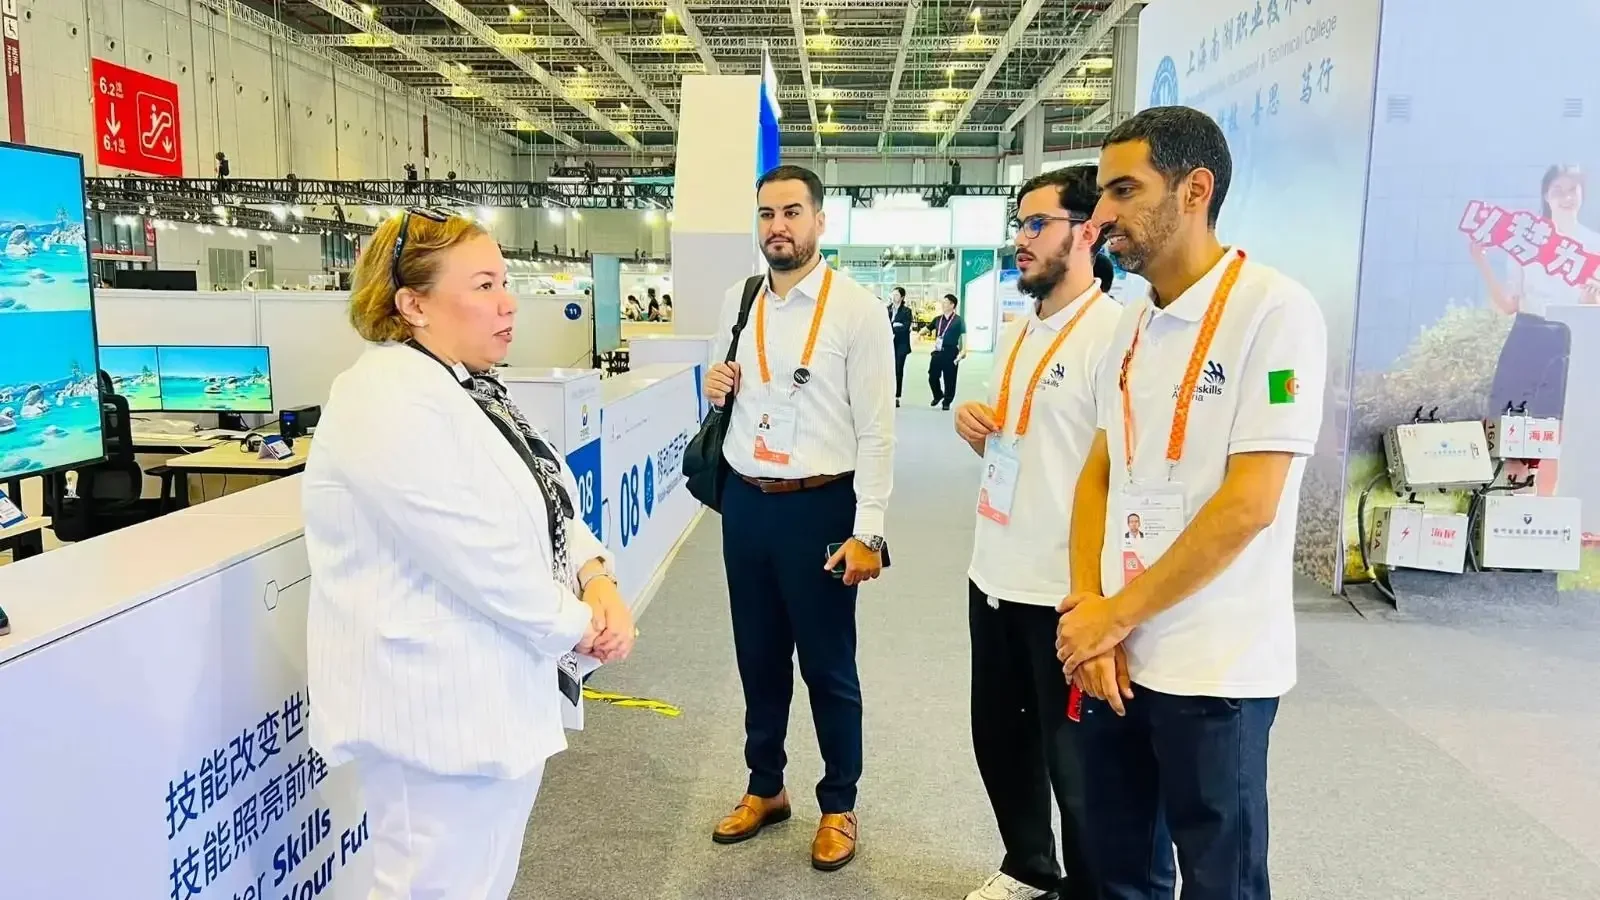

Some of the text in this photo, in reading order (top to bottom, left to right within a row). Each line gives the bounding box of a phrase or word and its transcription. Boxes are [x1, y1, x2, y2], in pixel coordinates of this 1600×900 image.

[1459, 201, 1600, 285] 以梦为
[1171, 391, 1204, 402] Aria
[577, 469, 594, 520] 08
[620, 464, 640, 548] 08
[170, 746, 328, 900] 技能照亮前程
[273, 807, 331, 887] Skills
[341, 810, 369, 866] Fut
